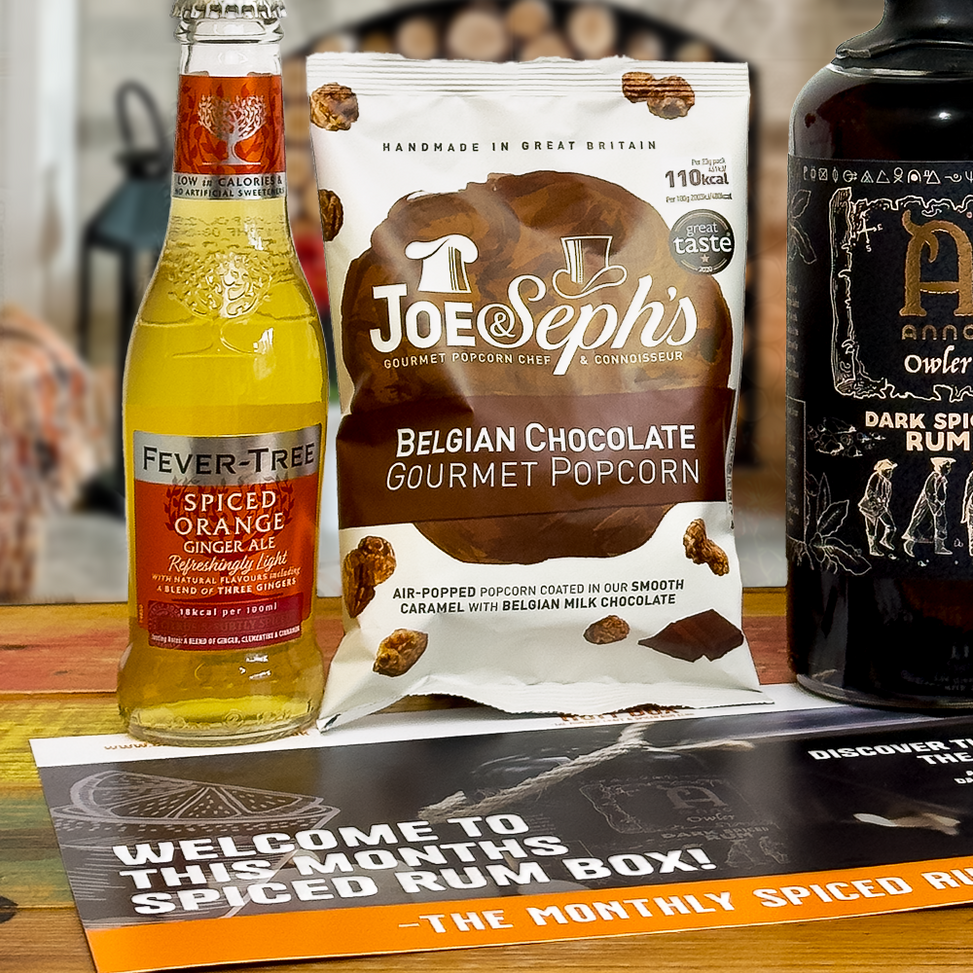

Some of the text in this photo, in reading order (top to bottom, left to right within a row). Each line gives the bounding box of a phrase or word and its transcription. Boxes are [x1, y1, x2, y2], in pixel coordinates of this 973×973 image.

[382, 140, 657, 153] HANDMADE IN GREAT BRITAIN
[177, 176, 198, 187] LOW
[202, 176, 213, 187] in
[218, 176, 276, 187] CALORIES
[665, 168, 730, 188] 110kcal
[185, 188, 234, 198] ARTIFICIAL
[686, 222, 719, 237] great
[672, 234, 732, 254] taste
[370, 274, 698, 375] JOE & Seph's
[383, 350, 684, 370] GOURMET POPCORN CHEF & CONNOISSEUR
[904, 345, 973, 375] Owler
[865, 411, 926, 430] DARK
[396, 422, 696, 458] BELGIAN CHOCOLATE
[906, 430, 971, 452] RUM
[143, 442, 316, 475] FEVER-TREE
[386, 455, 700, 491] GOURMET POPCORN
[184, 490, 277, 512] SPICED
[174, 512, 285, 536] ORANGE
[183, 536, 276, 554] GINGER ALE
[168, 550, 288, 576] Refreshingly Light
[164, 585, 198, 595] BLEND
[200, 588, 214, 596] OF
[217, 585, 253, 595] THREE
[256, 577, 297, 591] GINGERS
[173, 576, 217, 585] NATURAL
[220, 573, 268, 585] FLAVOURS
[269, 567, 302, 579] including
[393, 579, 685, 600] AIR-POPPED POPCORN COATED IN OUR SMOOTH
[179, 602, 278, 618] 18kcal per 100ml
[400, 593, 676, 614] CARAMEL WITH BELGIAN MILK CHOCOLATE
[808, 741, 951, 760] DISCOVER
[112, 813, 530, 867] WELCOME TO
[119, 835, 569, 890] THIS MONTHS
[131, 848, 718, 915] SPICED RUM BOX!
[526, 891, 736, 927] MONTHLY
[752, 875, 913, 909] SPICED
